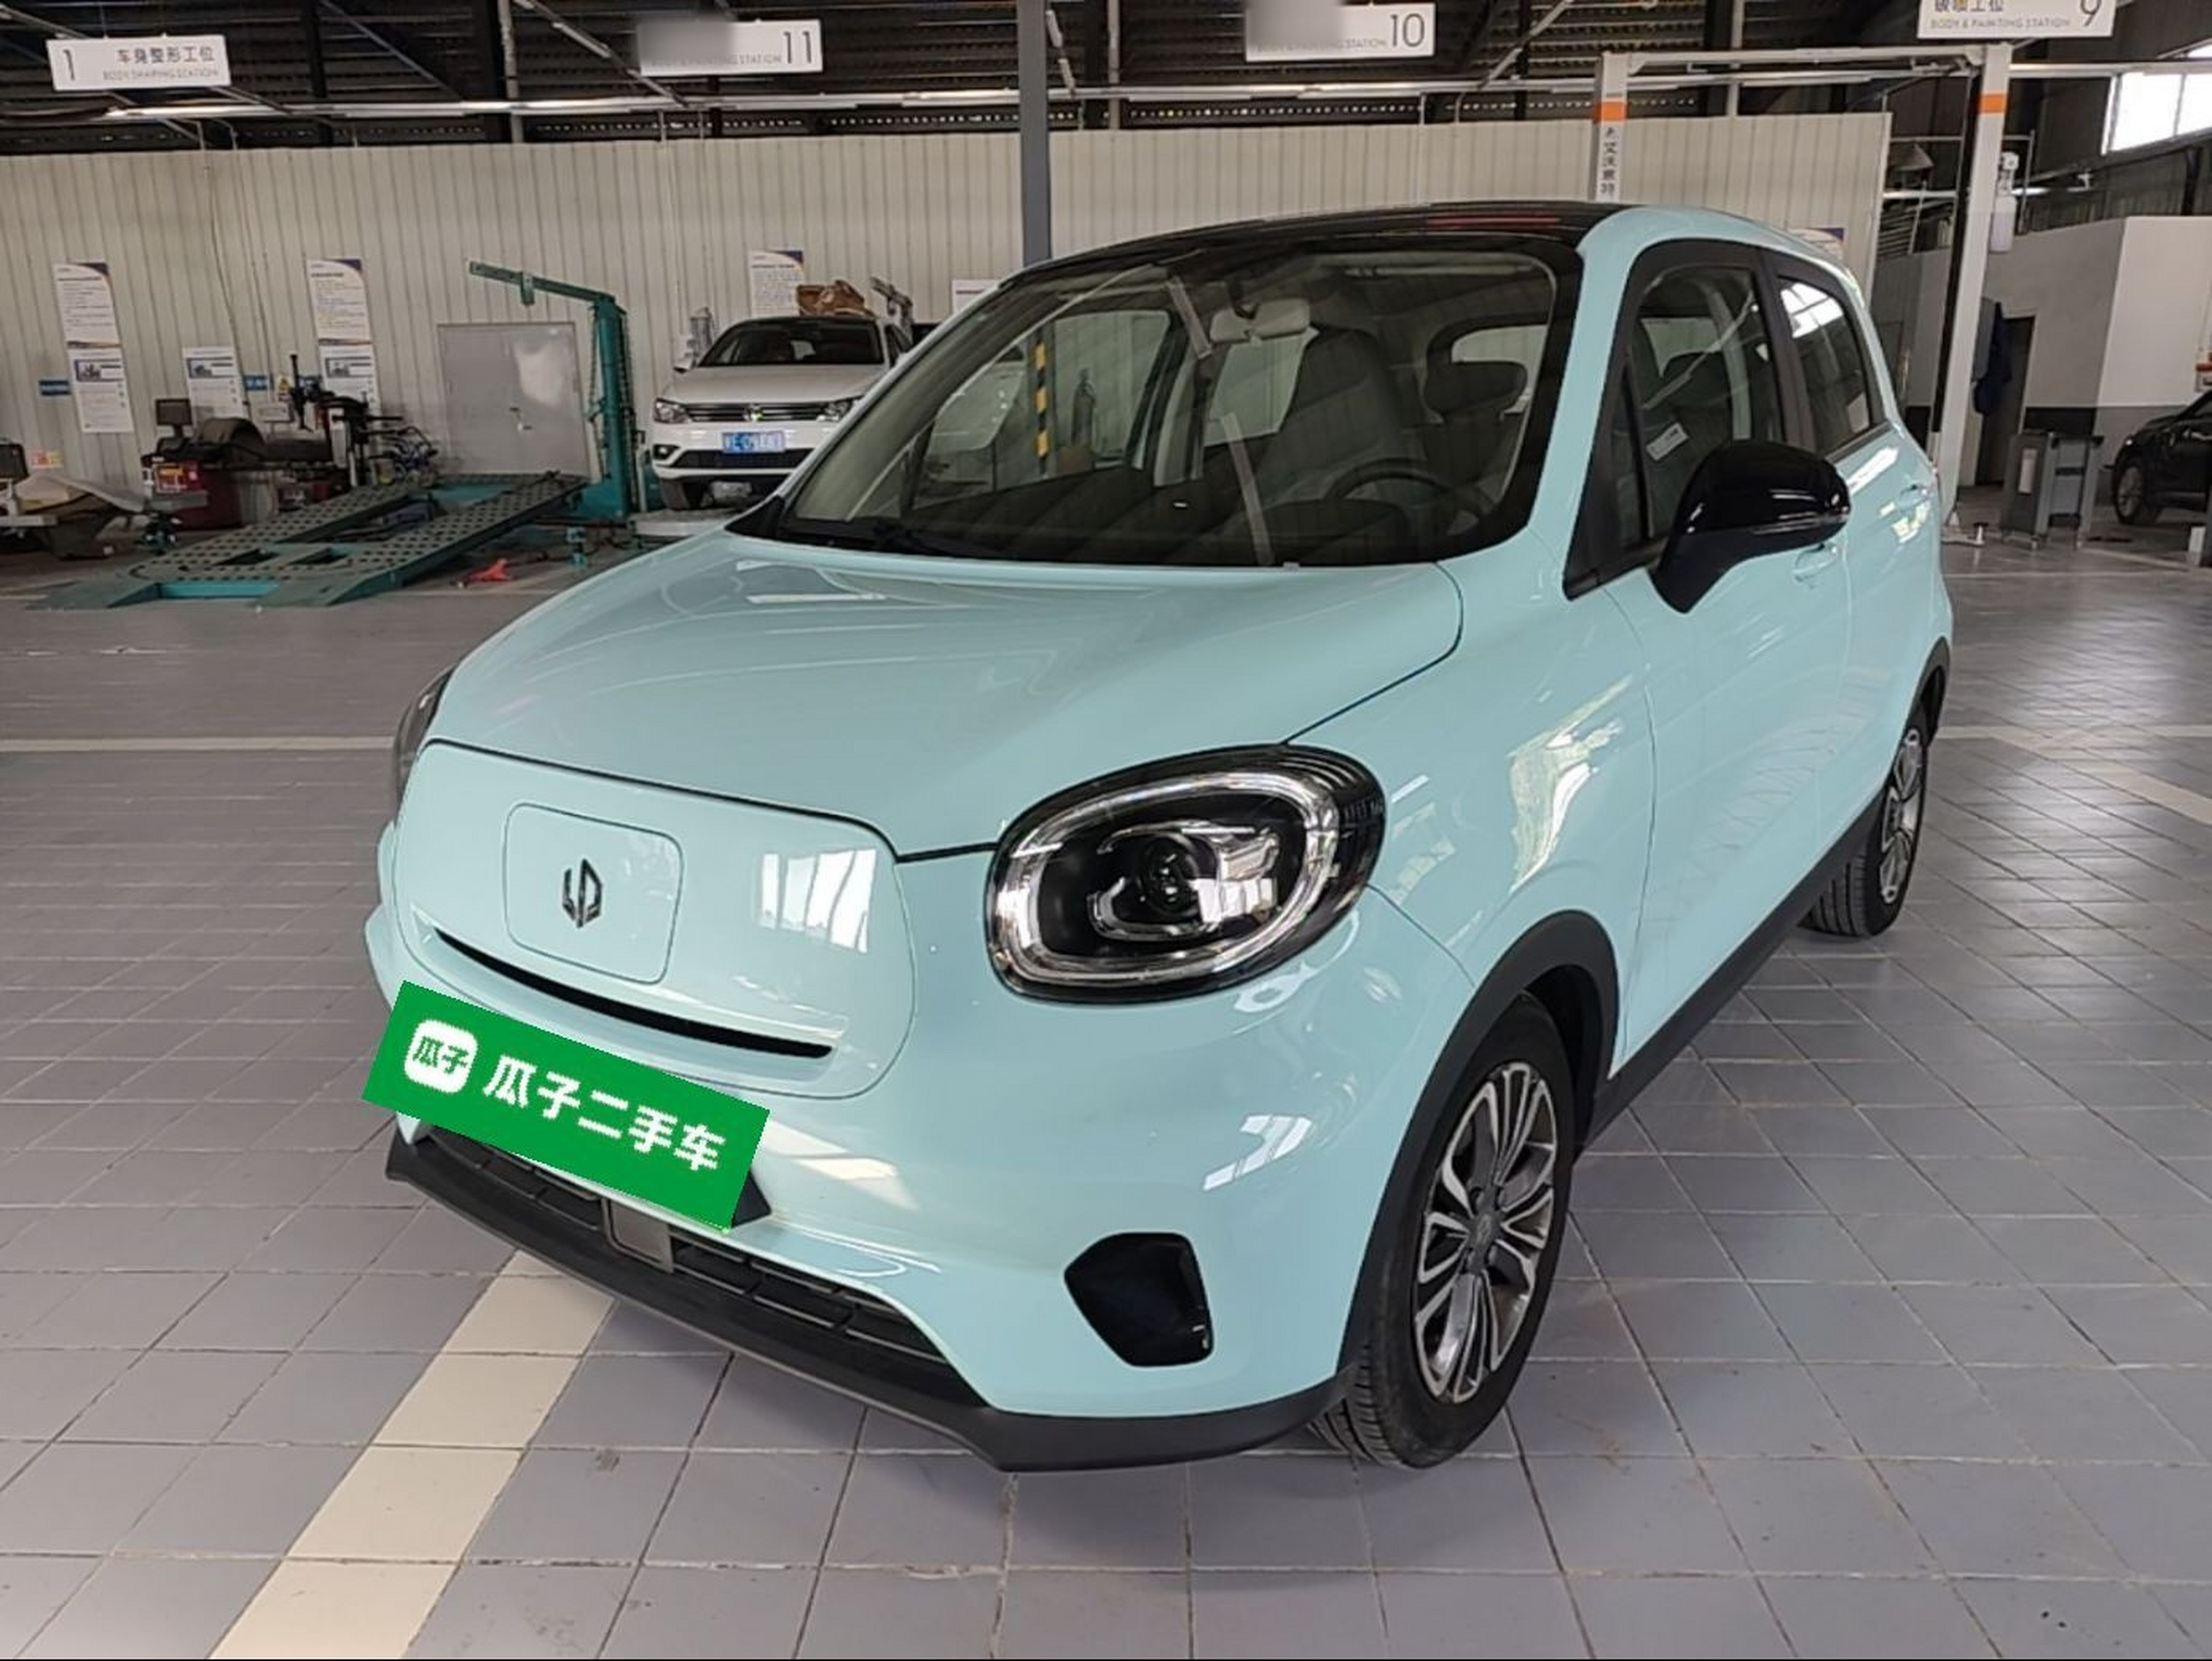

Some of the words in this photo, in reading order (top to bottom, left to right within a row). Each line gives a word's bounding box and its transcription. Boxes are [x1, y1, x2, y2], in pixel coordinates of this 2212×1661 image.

[2080, 0, 2101, 27] 9
[1390, 13, 1426, 47] 10
[783, 31, 812, 64] 11
[63, 49, 75, 81] 1
